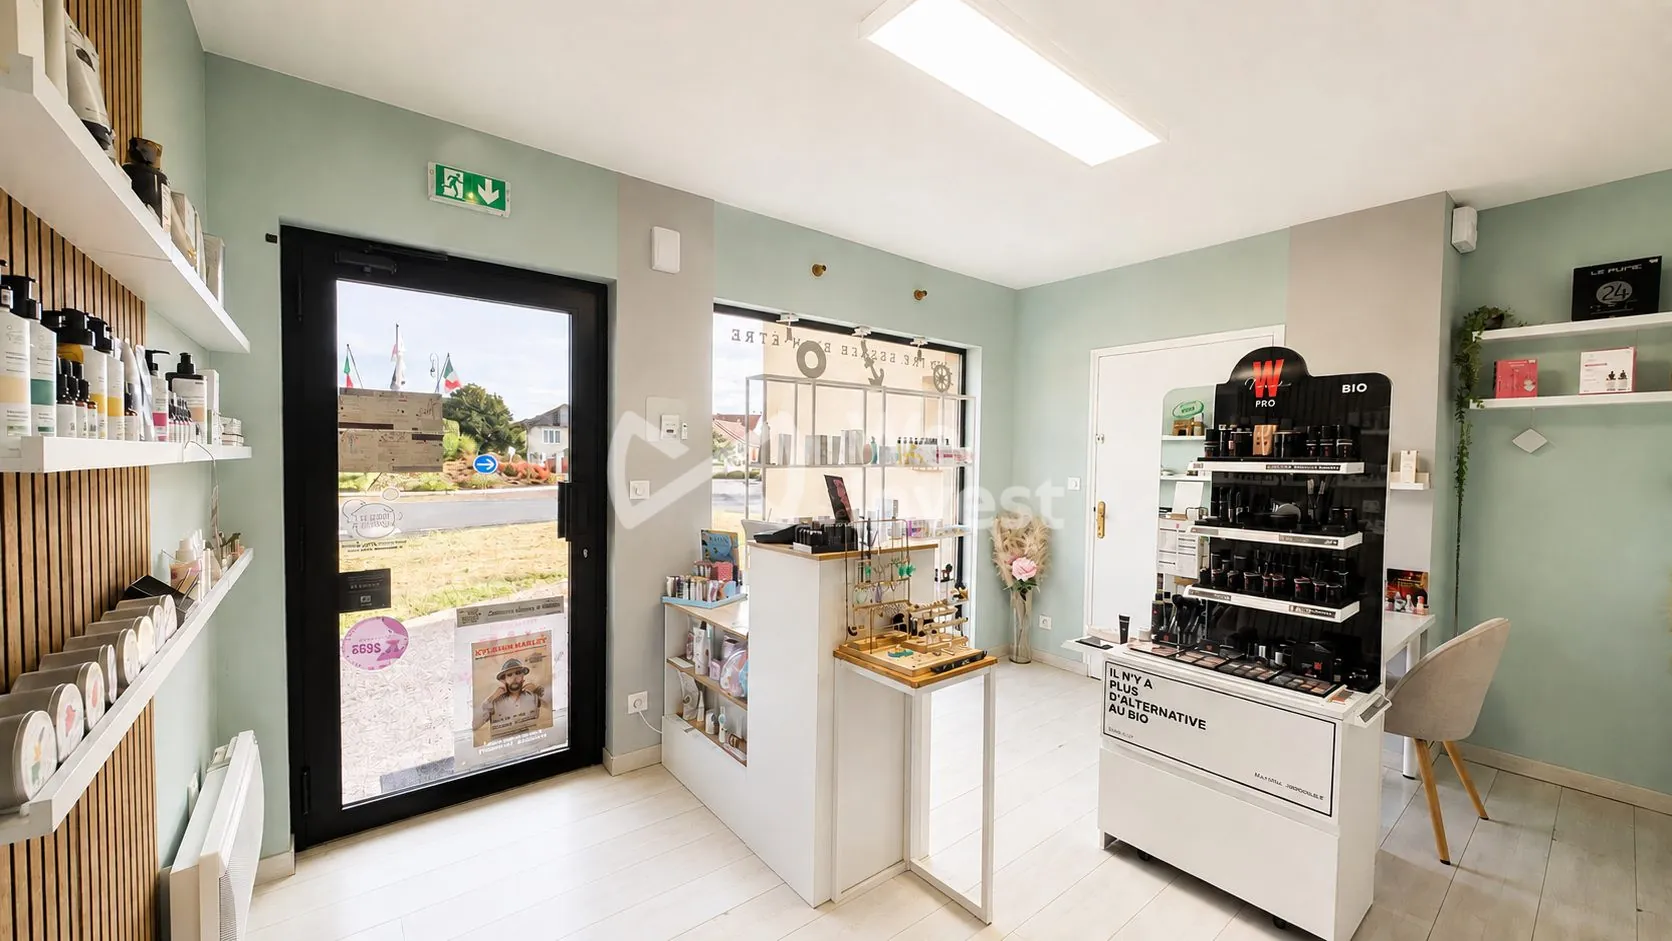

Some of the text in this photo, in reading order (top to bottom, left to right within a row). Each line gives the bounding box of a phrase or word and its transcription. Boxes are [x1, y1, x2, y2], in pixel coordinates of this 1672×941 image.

[1342, 383, 1368, 394] BIO
[1255, 399, 1276, 408] PRO
[1110, 668, 1153, 690] IL N'Y A
[1109, 680, 1138, 697] PLUS
[1108, 704, 1149, 724] AU BIO
[1109, 692, 1206, 731] D'ALTERNATIVE
